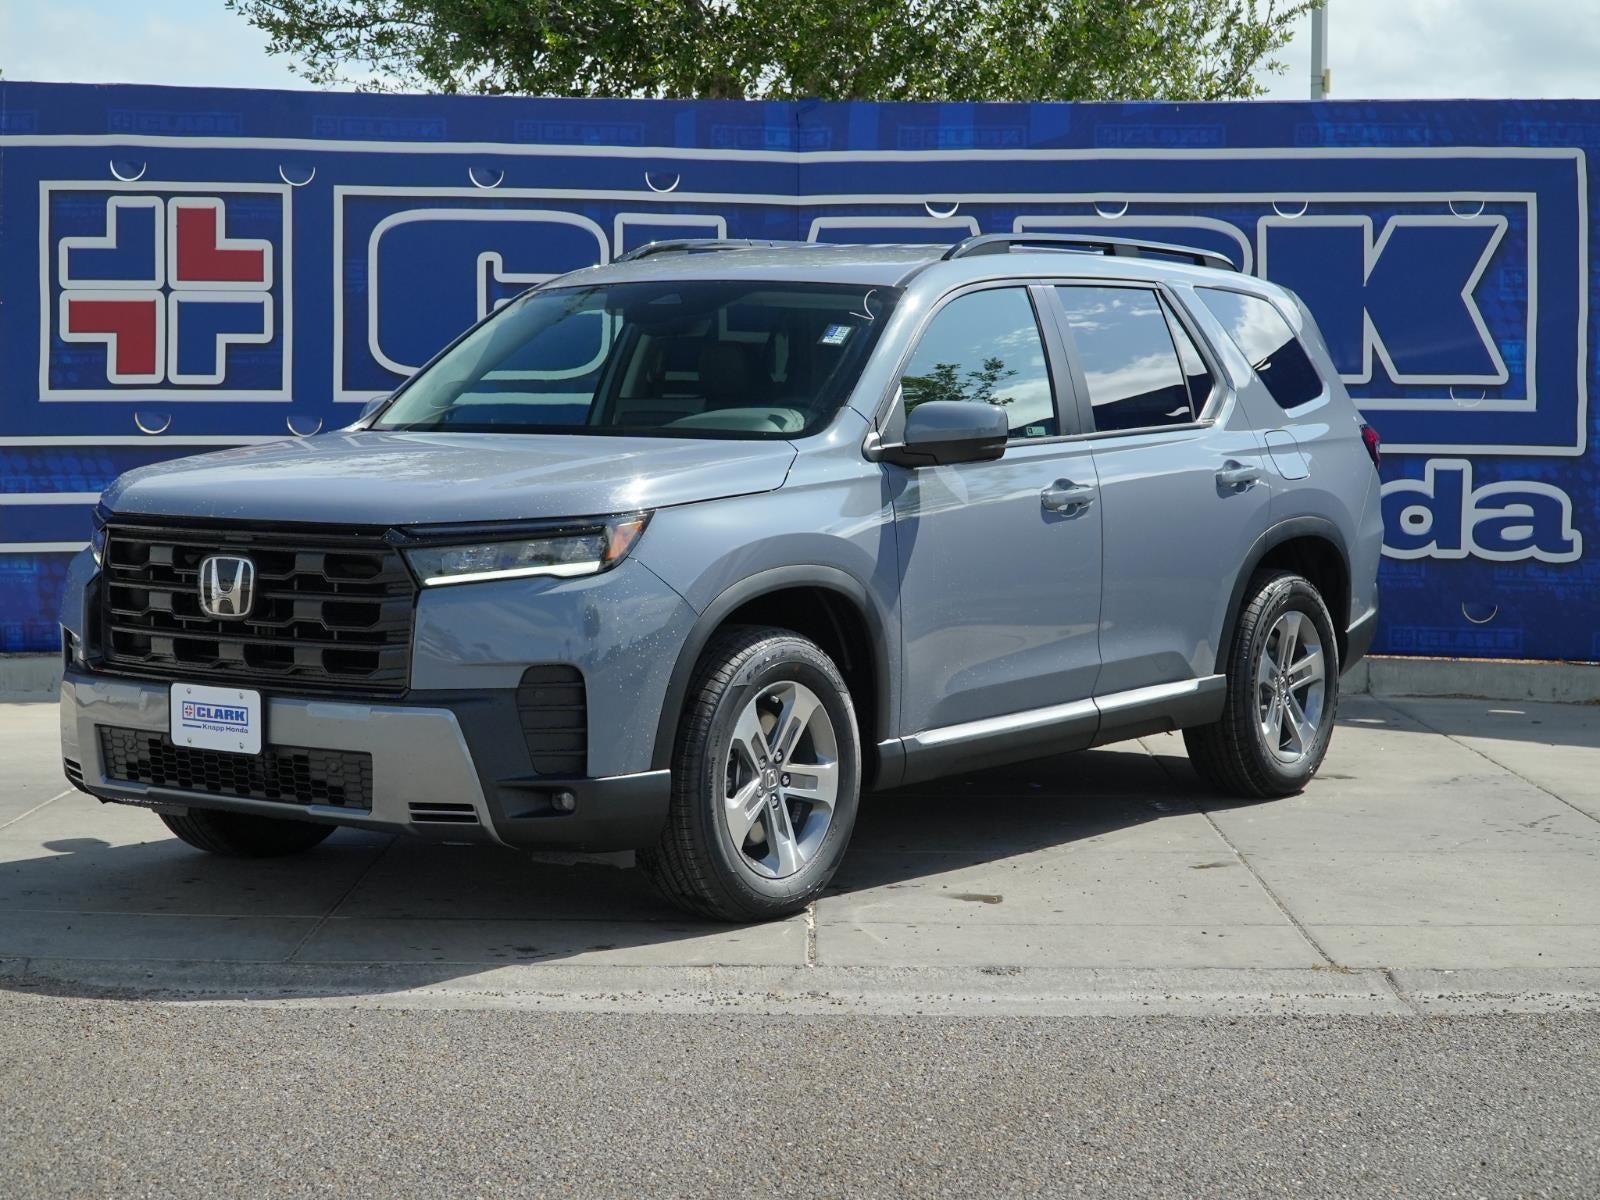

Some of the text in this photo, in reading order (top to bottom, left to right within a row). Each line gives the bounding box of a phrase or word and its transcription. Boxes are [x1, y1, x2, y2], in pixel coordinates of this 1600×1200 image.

[197, 706, 245, 721] CLARK
[202, 723, 248, 734] Knapp Honda
